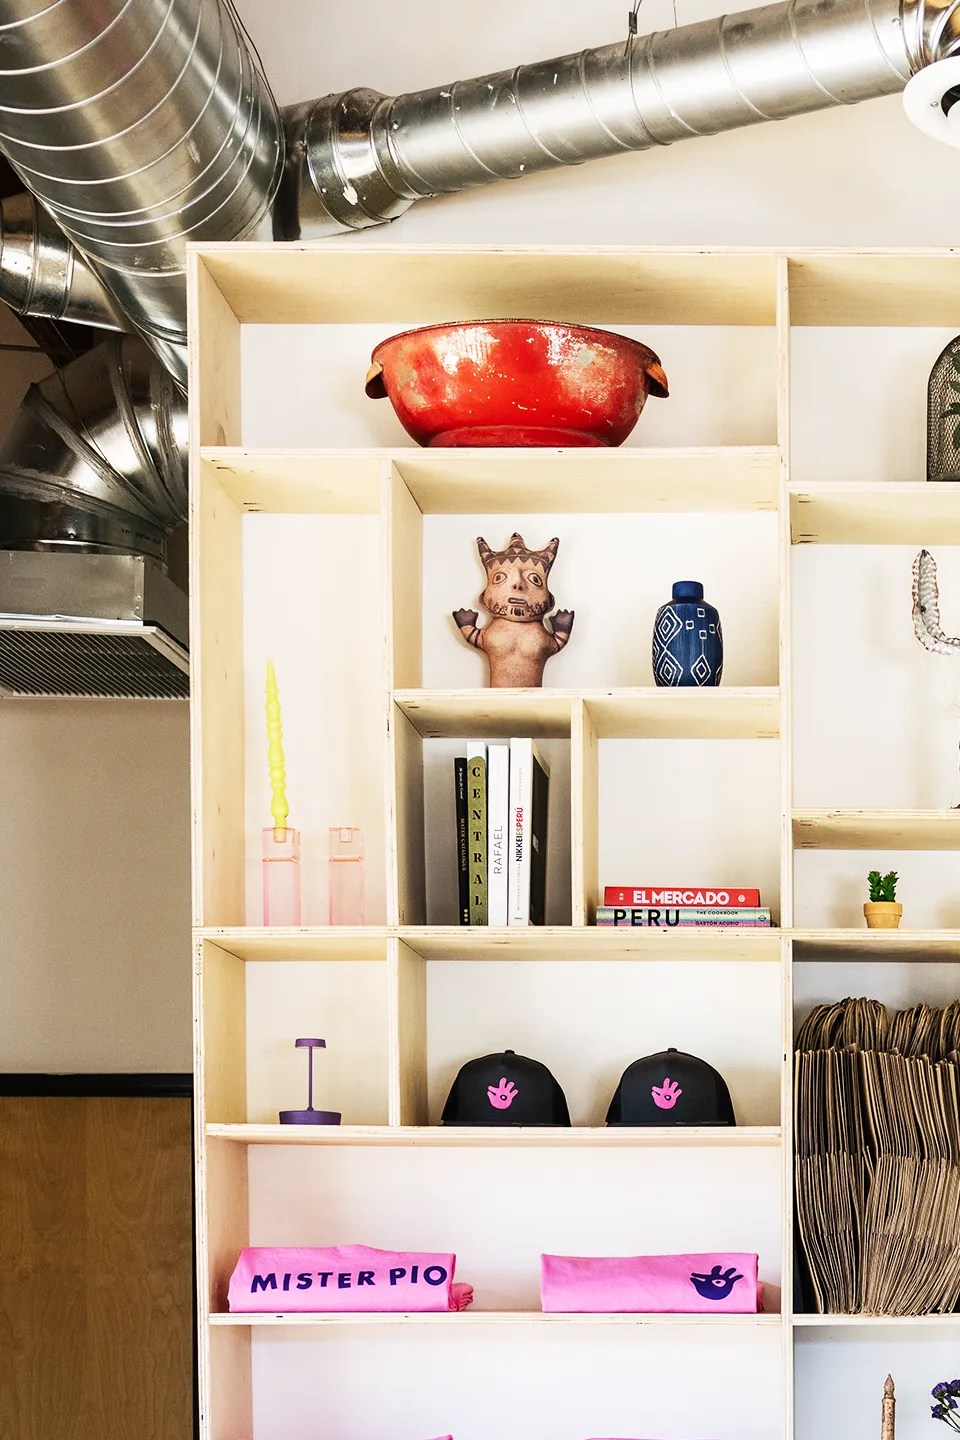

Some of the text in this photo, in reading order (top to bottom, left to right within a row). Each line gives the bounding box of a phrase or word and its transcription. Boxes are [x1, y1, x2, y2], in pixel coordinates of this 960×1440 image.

[472, 766, 483, 906] CENTRAL
[493, 825, 503, 874] RAFAEL
[633, 890, 730, 905] EL MERCADO
[614, 909, 680, 927] PERU
[250, 1265, 448, 1294] MISTER PIO
